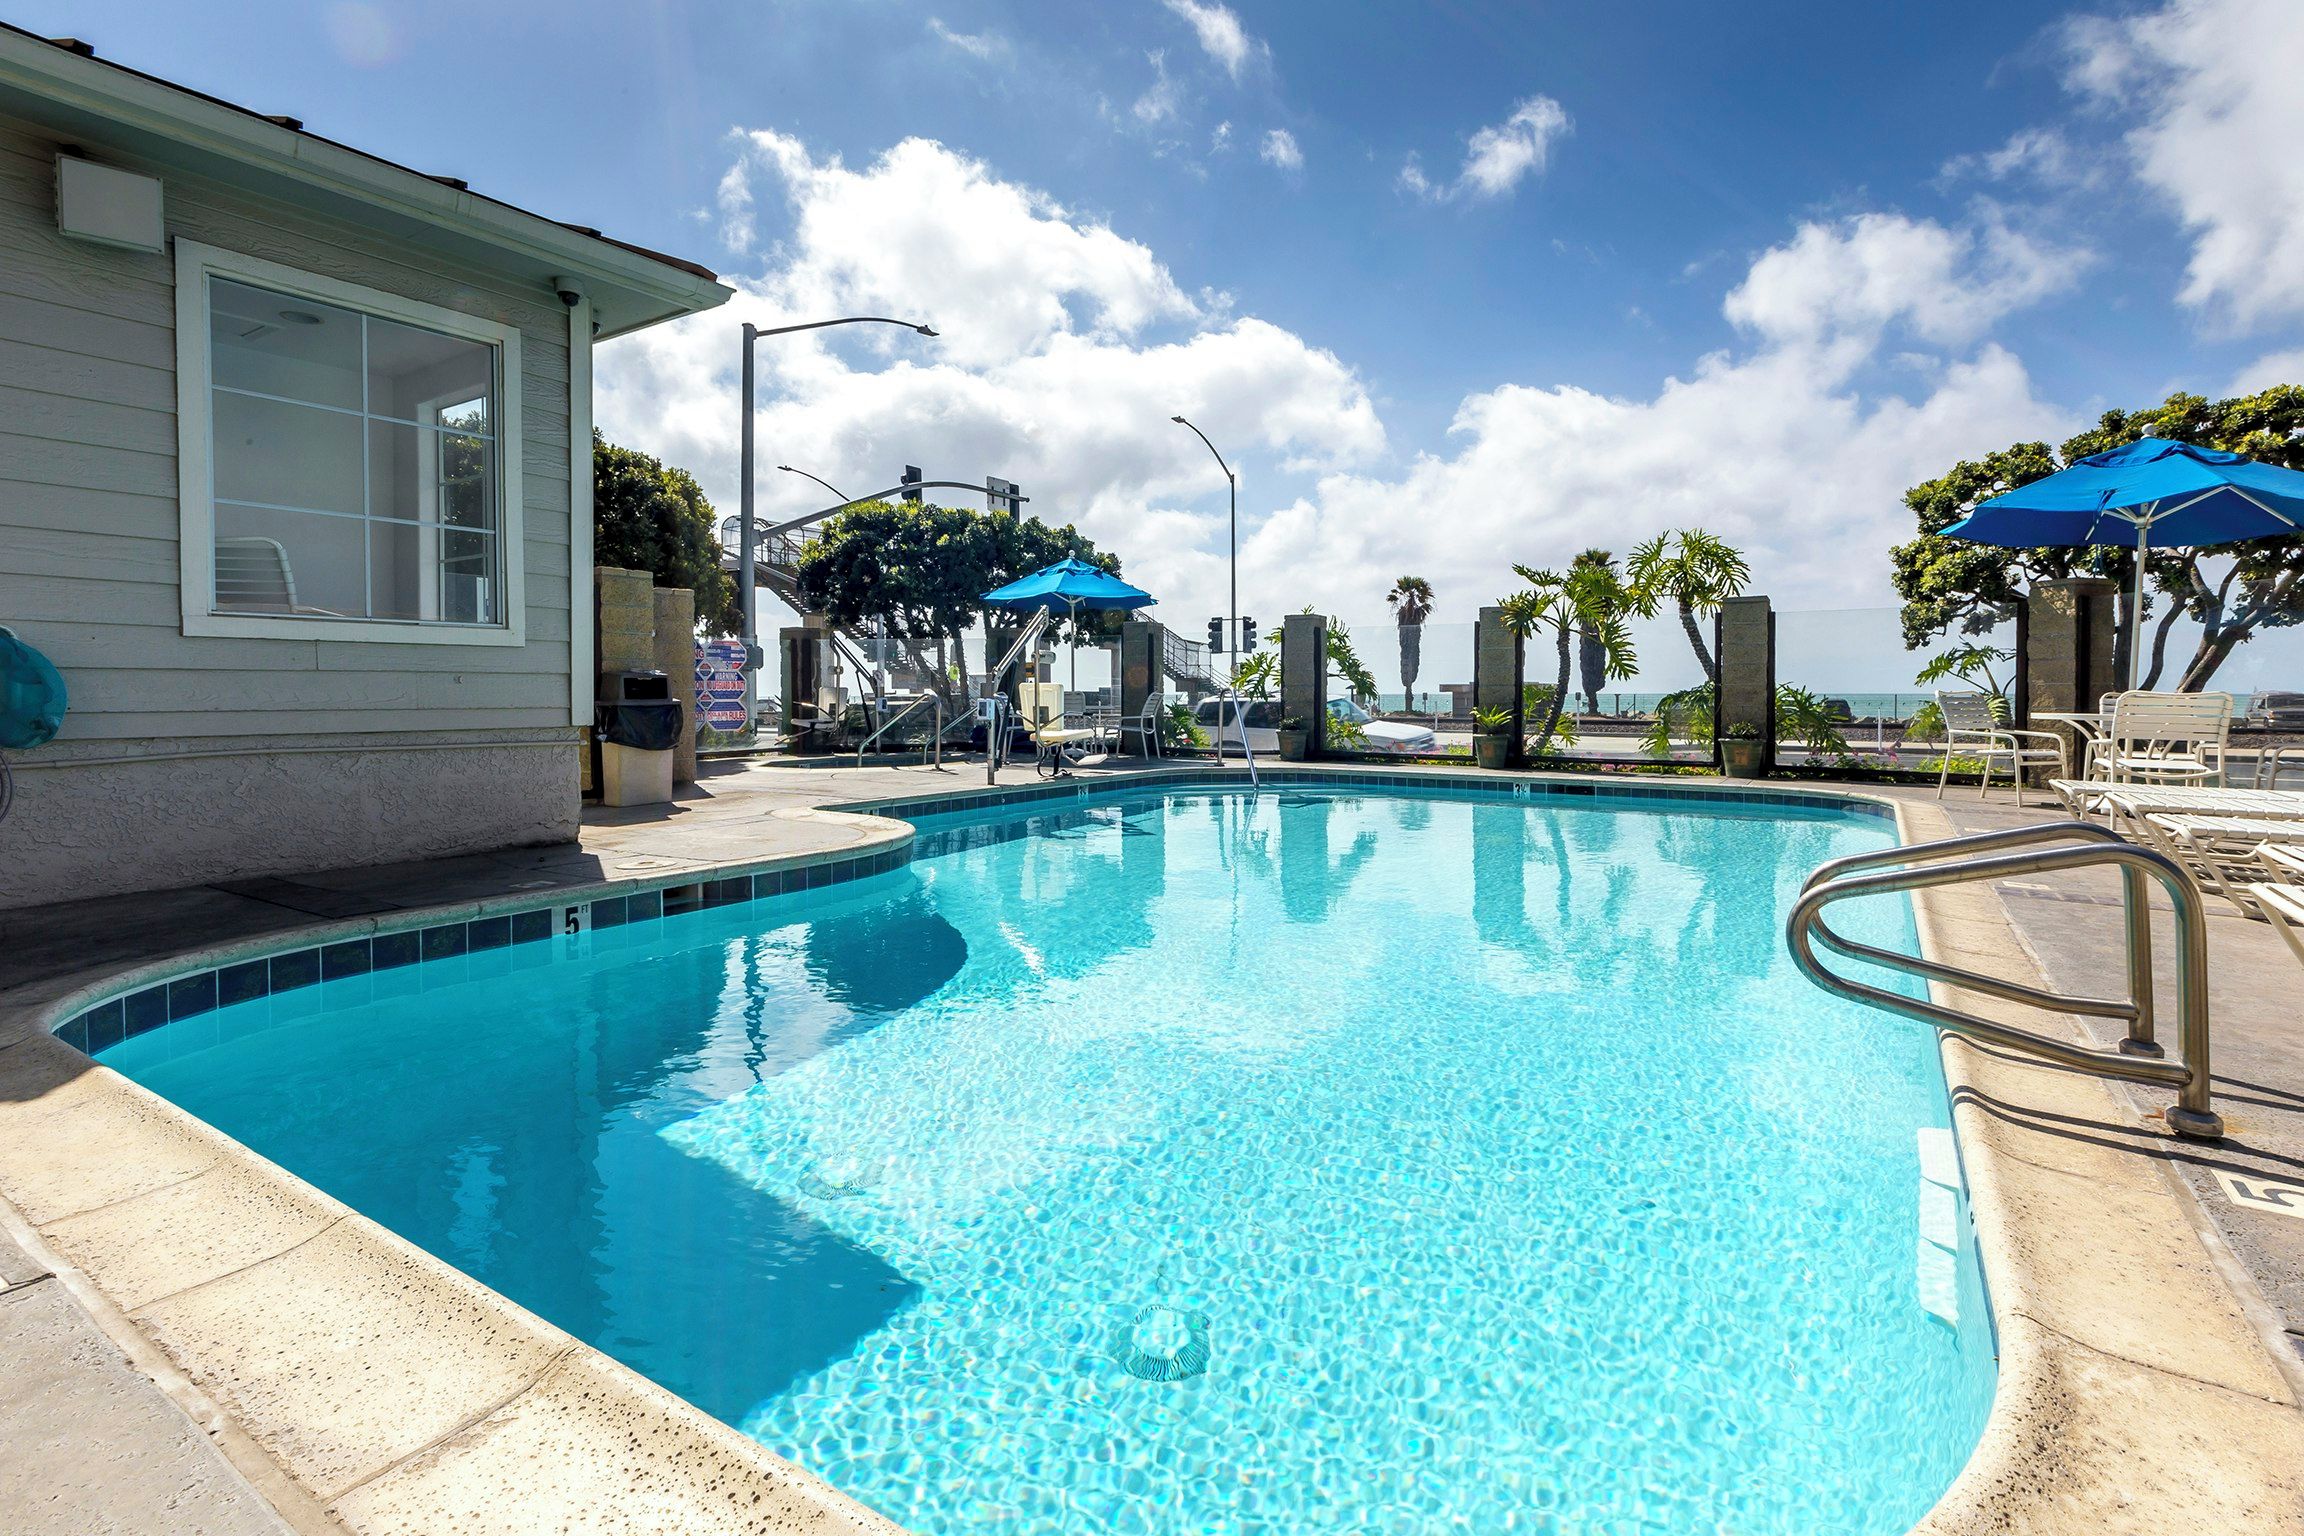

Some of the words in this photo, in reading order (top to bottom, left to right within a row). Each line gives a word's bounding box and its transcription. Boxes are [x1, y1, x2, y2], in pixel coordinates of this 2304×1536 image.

[729, 711, 746, 721] RULES
[565, 906, 580, 935] 5
[581, 904, 589, 914] FT
